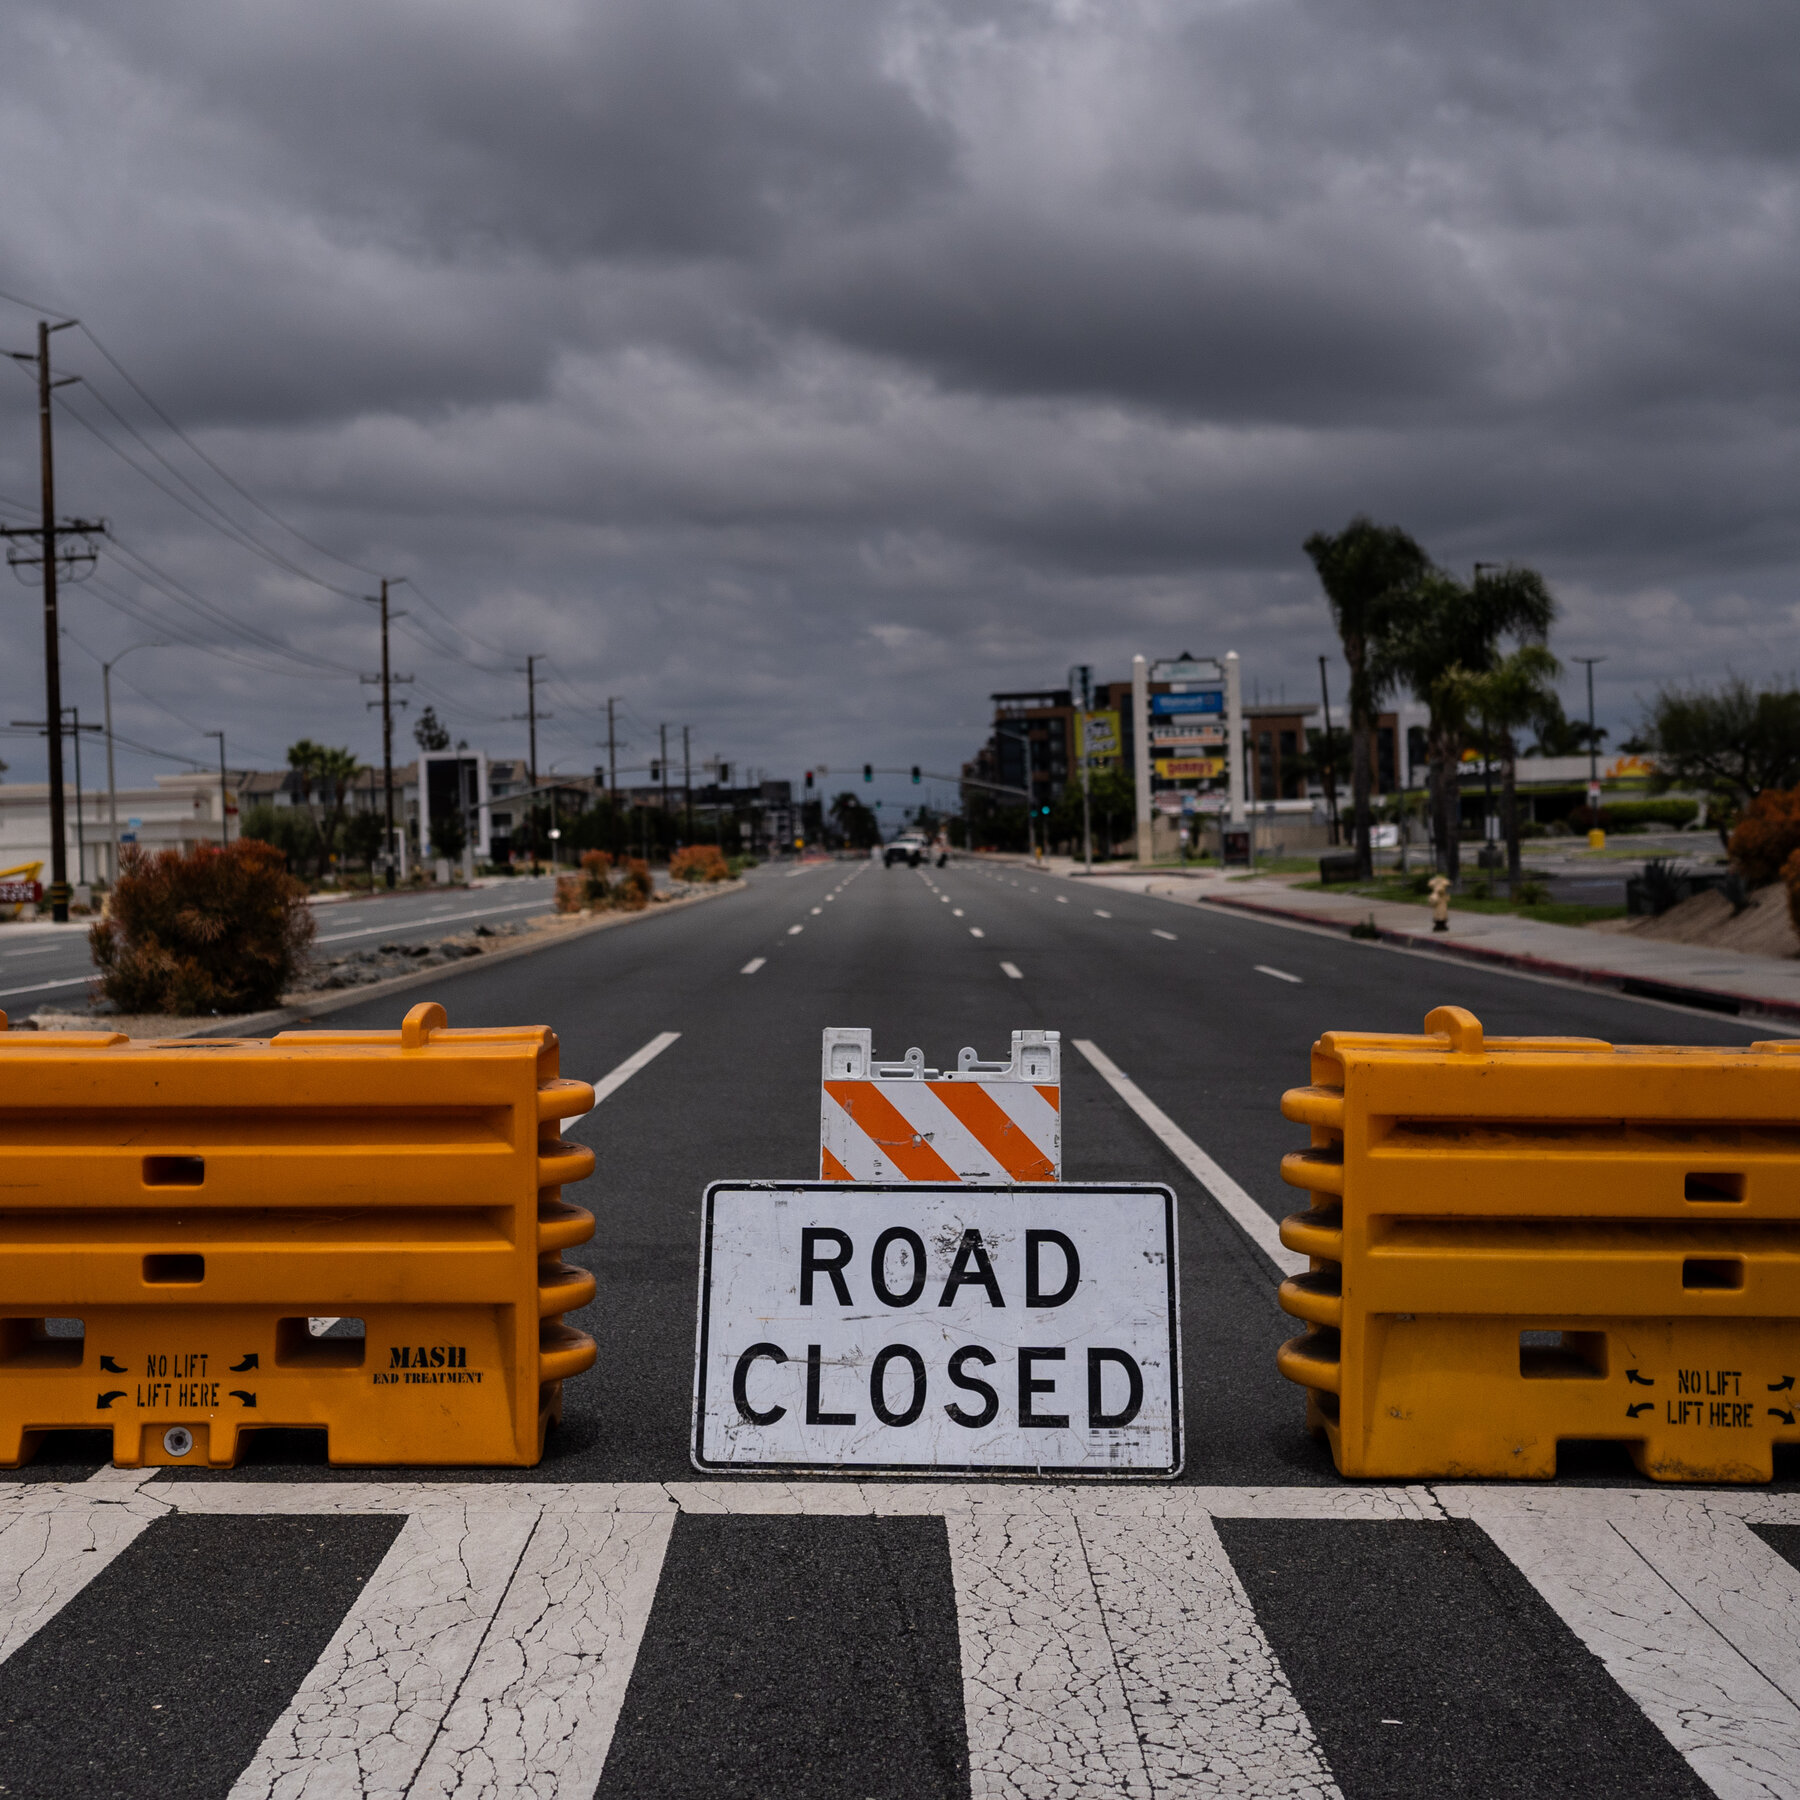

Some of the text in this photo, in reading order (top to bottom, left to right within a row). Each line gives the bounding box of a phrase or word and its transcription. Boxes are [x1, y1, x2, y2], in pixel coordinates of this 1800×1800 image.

[800, 1226, 1082, 1309] ROAD
[146, 1354, 209, 1378] NO LIFT
[389, 1346, 467, 1369] MASH
[373, 1372, 484, 1385] END TREATMENT
[732, 1342, 1144, 1429] CLOSED
[1678, 1369, 1742, 1396] NO LIFT
[137, 1383, 220, 1407] LIFT HERE
[1667, 1400, 1754, 1427] LIFT HERE
